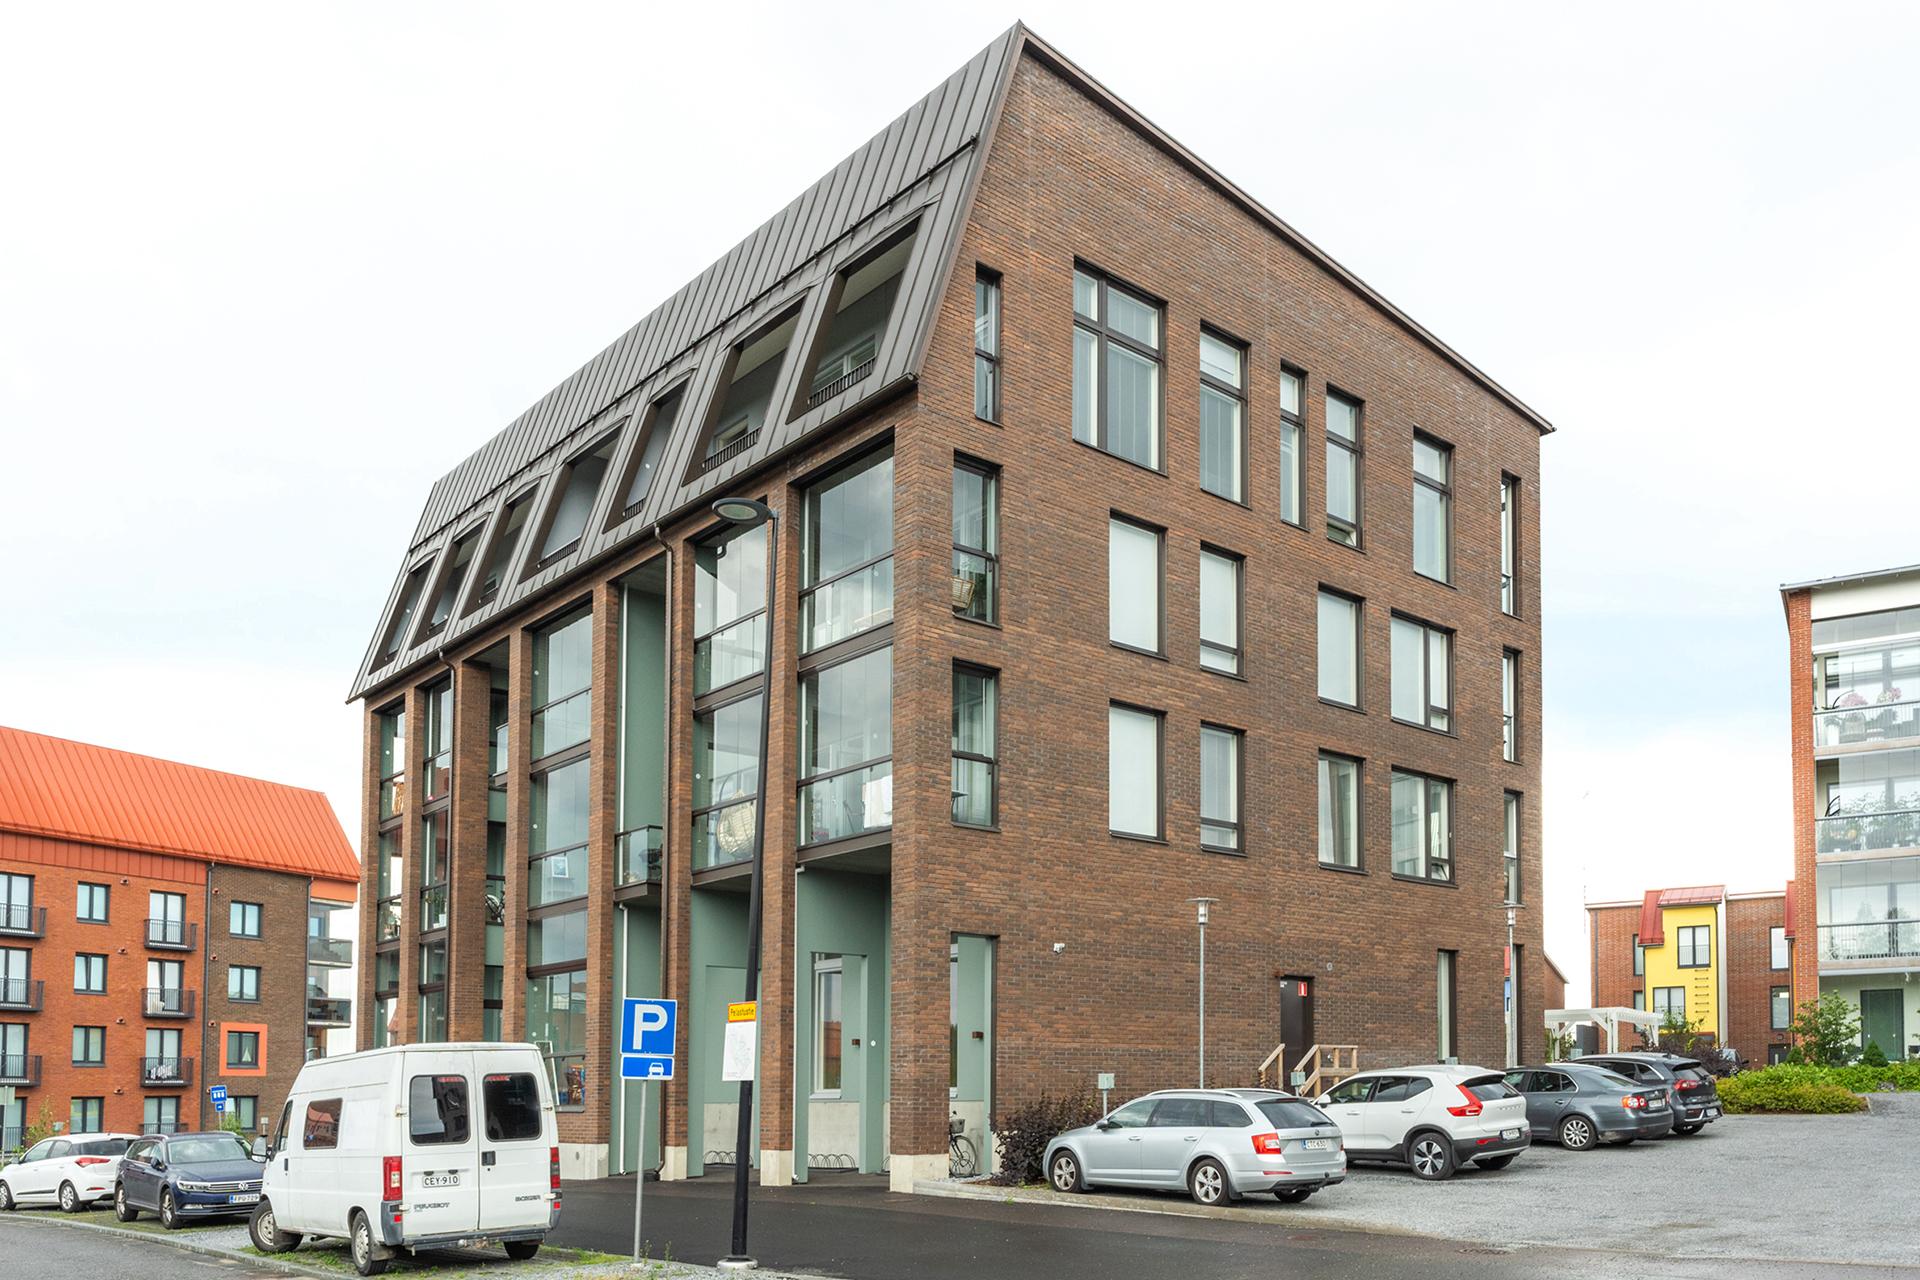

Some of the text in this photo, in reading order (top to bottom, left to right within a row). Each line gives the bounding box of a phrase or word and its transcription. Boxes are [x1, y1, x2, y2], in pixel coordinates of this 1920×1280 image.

[632, 1003, 668, 1050] P
[424, 1176, 458, 1186] CEY-910
[414, 1202, 450, 1210] PEUGEOT
